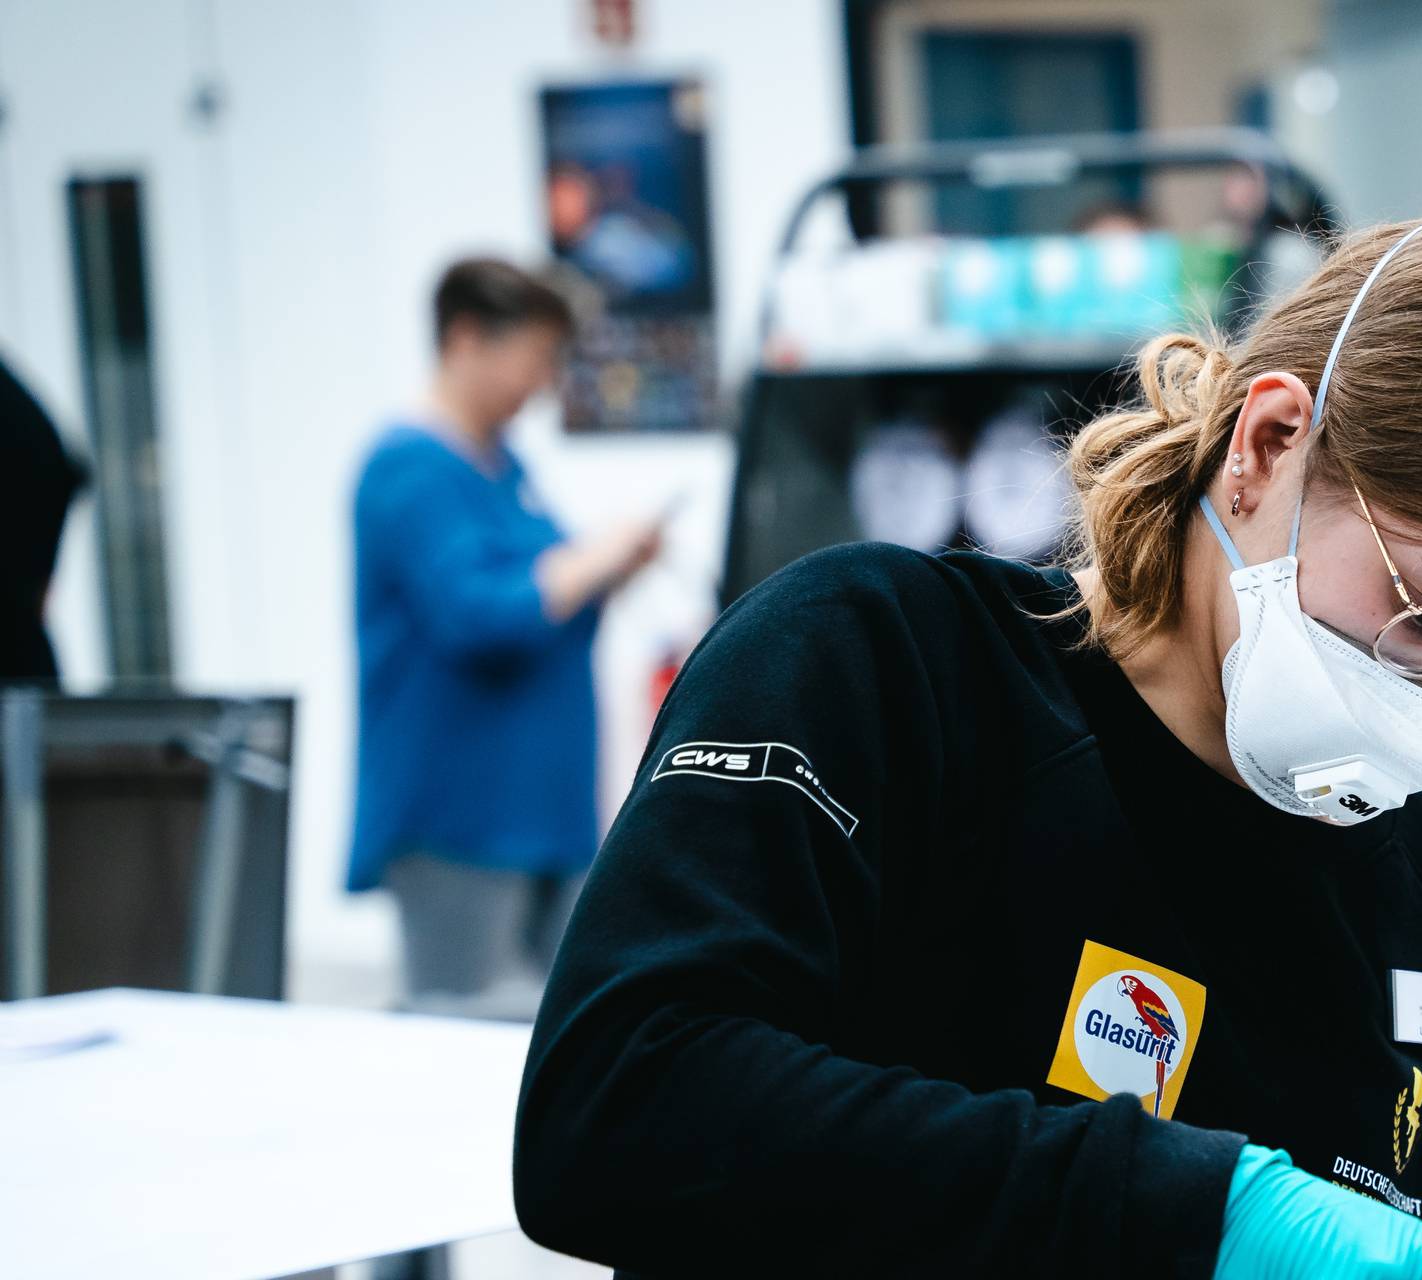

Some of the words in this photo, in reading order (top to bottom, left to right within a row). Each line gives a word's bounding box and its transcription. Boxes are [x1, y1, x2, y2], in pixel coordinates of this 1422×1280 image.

[672, 750, 750, 771] CWS
[1339, 794, 1380, 816] 3M
[1086, 1009, 1176, 1064] Glasurit
[1332, 1156, 1389, 1195] DEUTSCHE
